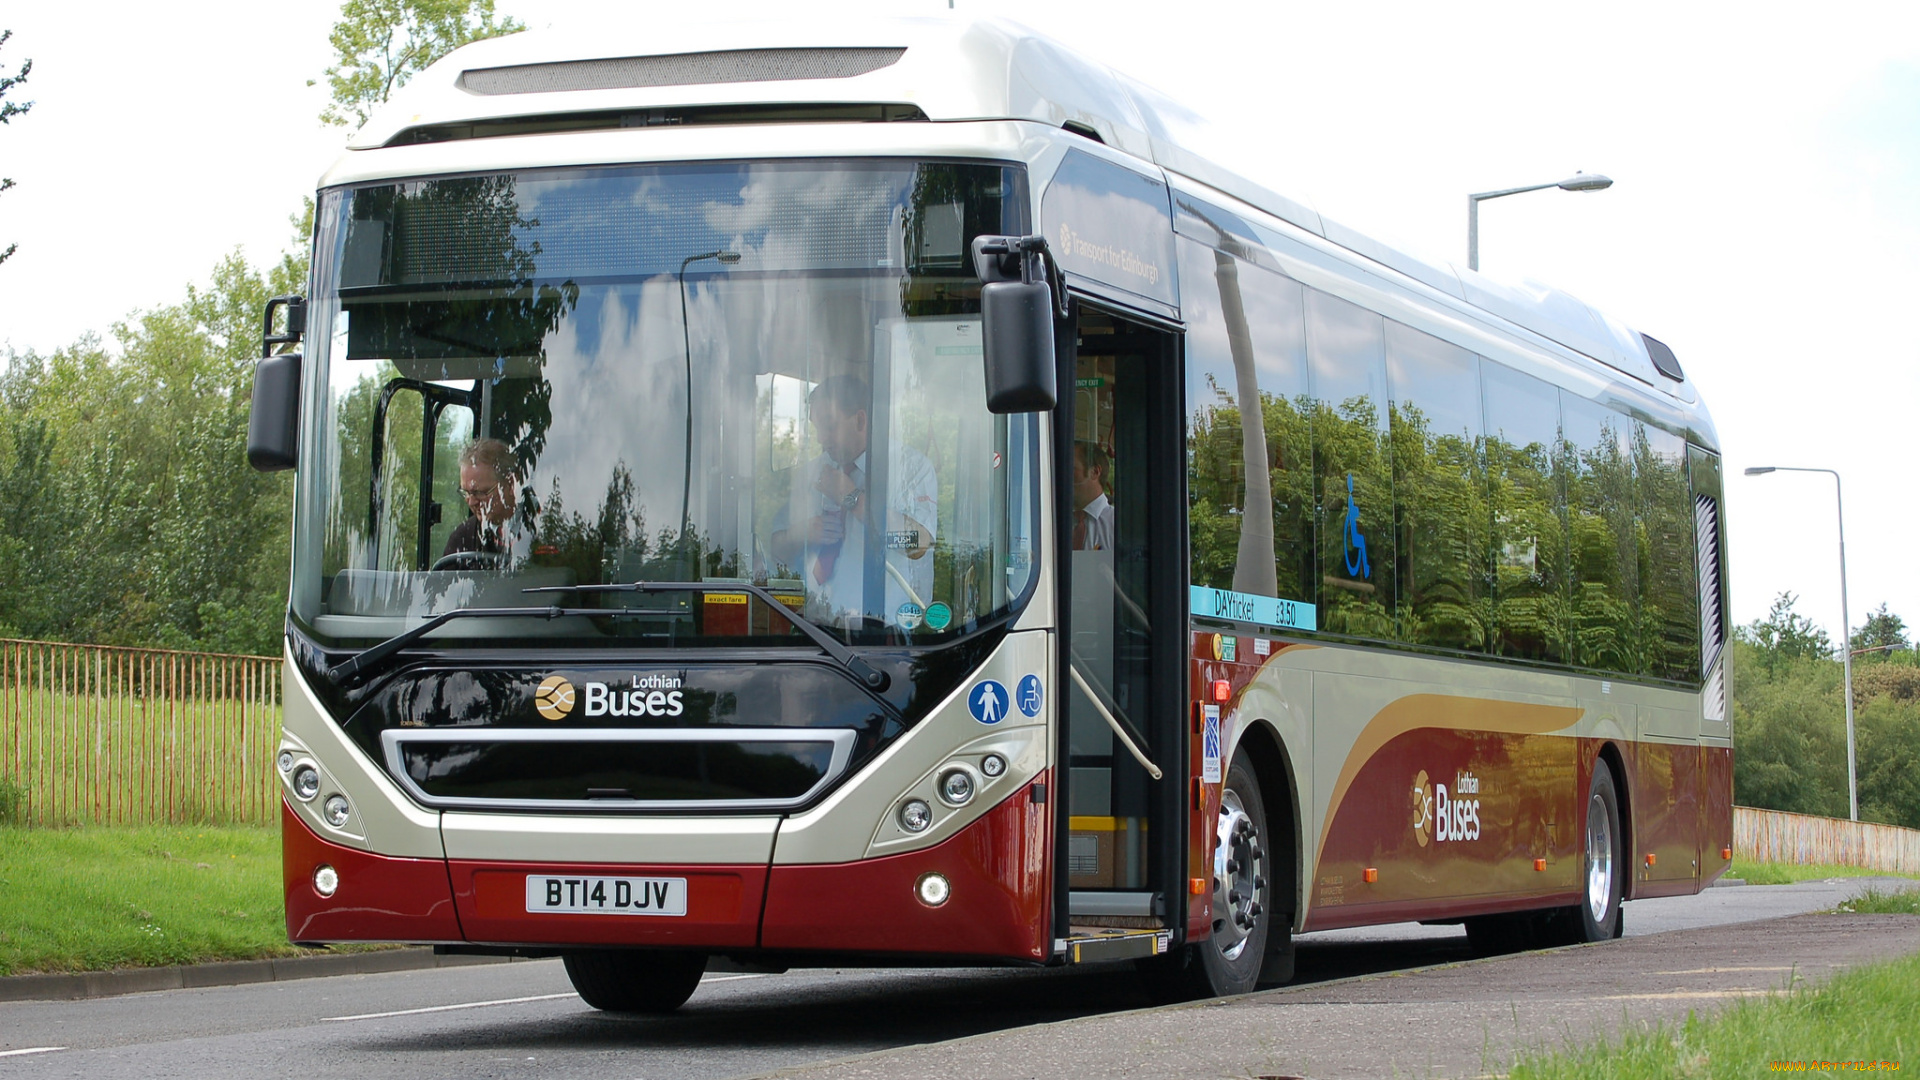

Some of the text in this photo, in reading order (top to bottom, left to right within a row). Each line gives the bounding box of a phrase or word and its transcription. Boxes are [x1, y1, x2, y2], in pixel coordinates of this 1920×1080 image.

[1071, 231, 1159, 286] Transport for Edinburgh
[893, 536, 911, 544] PUSH
[728, 595, 743, 603] fare
[1214, 590, 1297, 626] DAYticket £3.50
[632, 674, 681, 689] Lothian
[584, 681, 684, 717] Buses
[1457, 771, 1479, 794] Lothian
[1436, 783, 1480, 842] Buses
[545, 878, 669, 909] BT14 DJV
